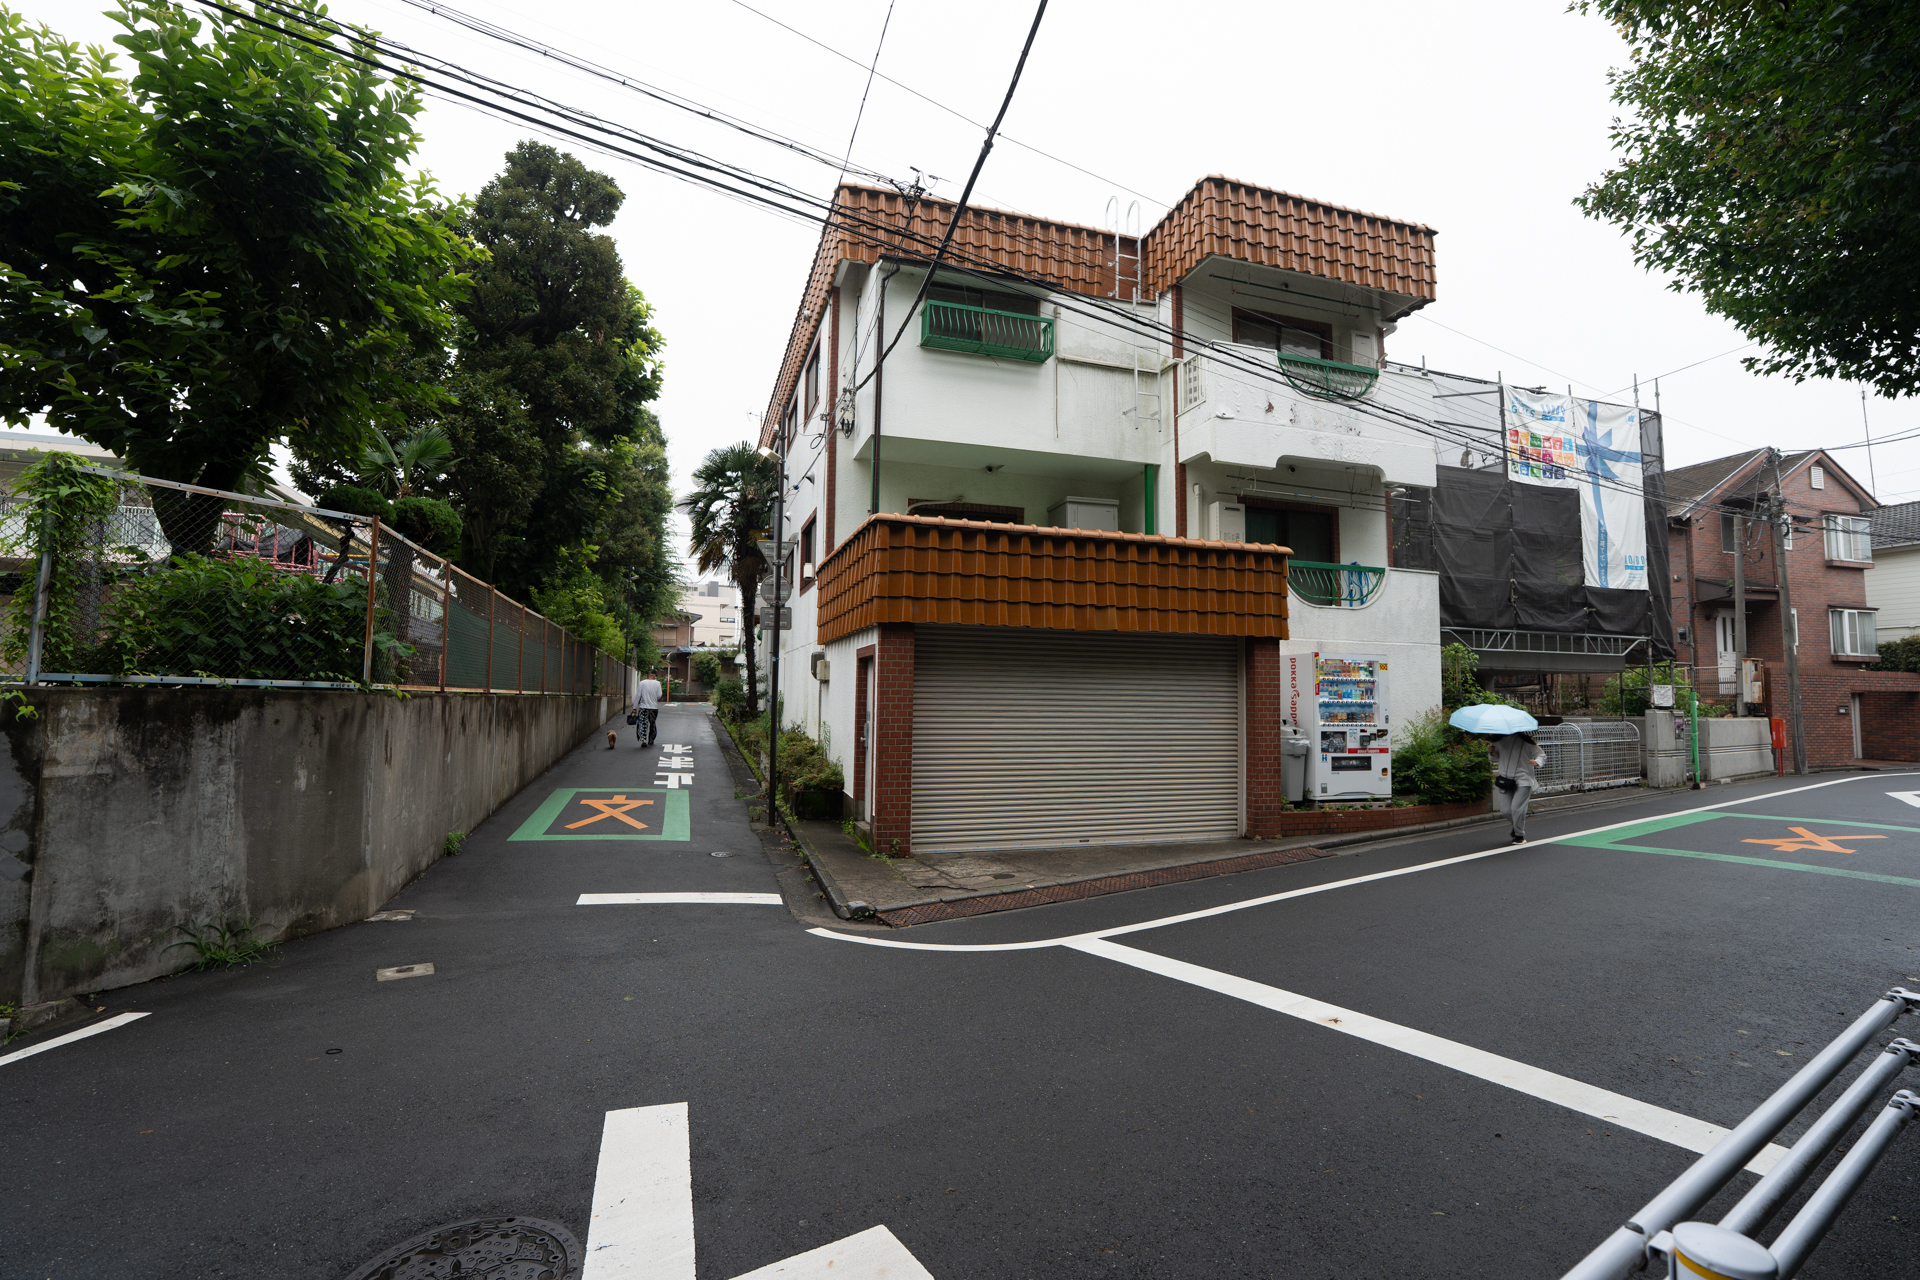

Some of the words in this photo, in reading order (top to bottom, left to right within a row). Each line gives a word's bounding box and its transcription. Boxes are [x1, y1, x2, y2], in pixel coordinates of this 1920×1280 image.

[653, 743, 695, 789] 止まれ
[563, 795, 654, 830] 文
[1740, 826, 1889, 854] 文
